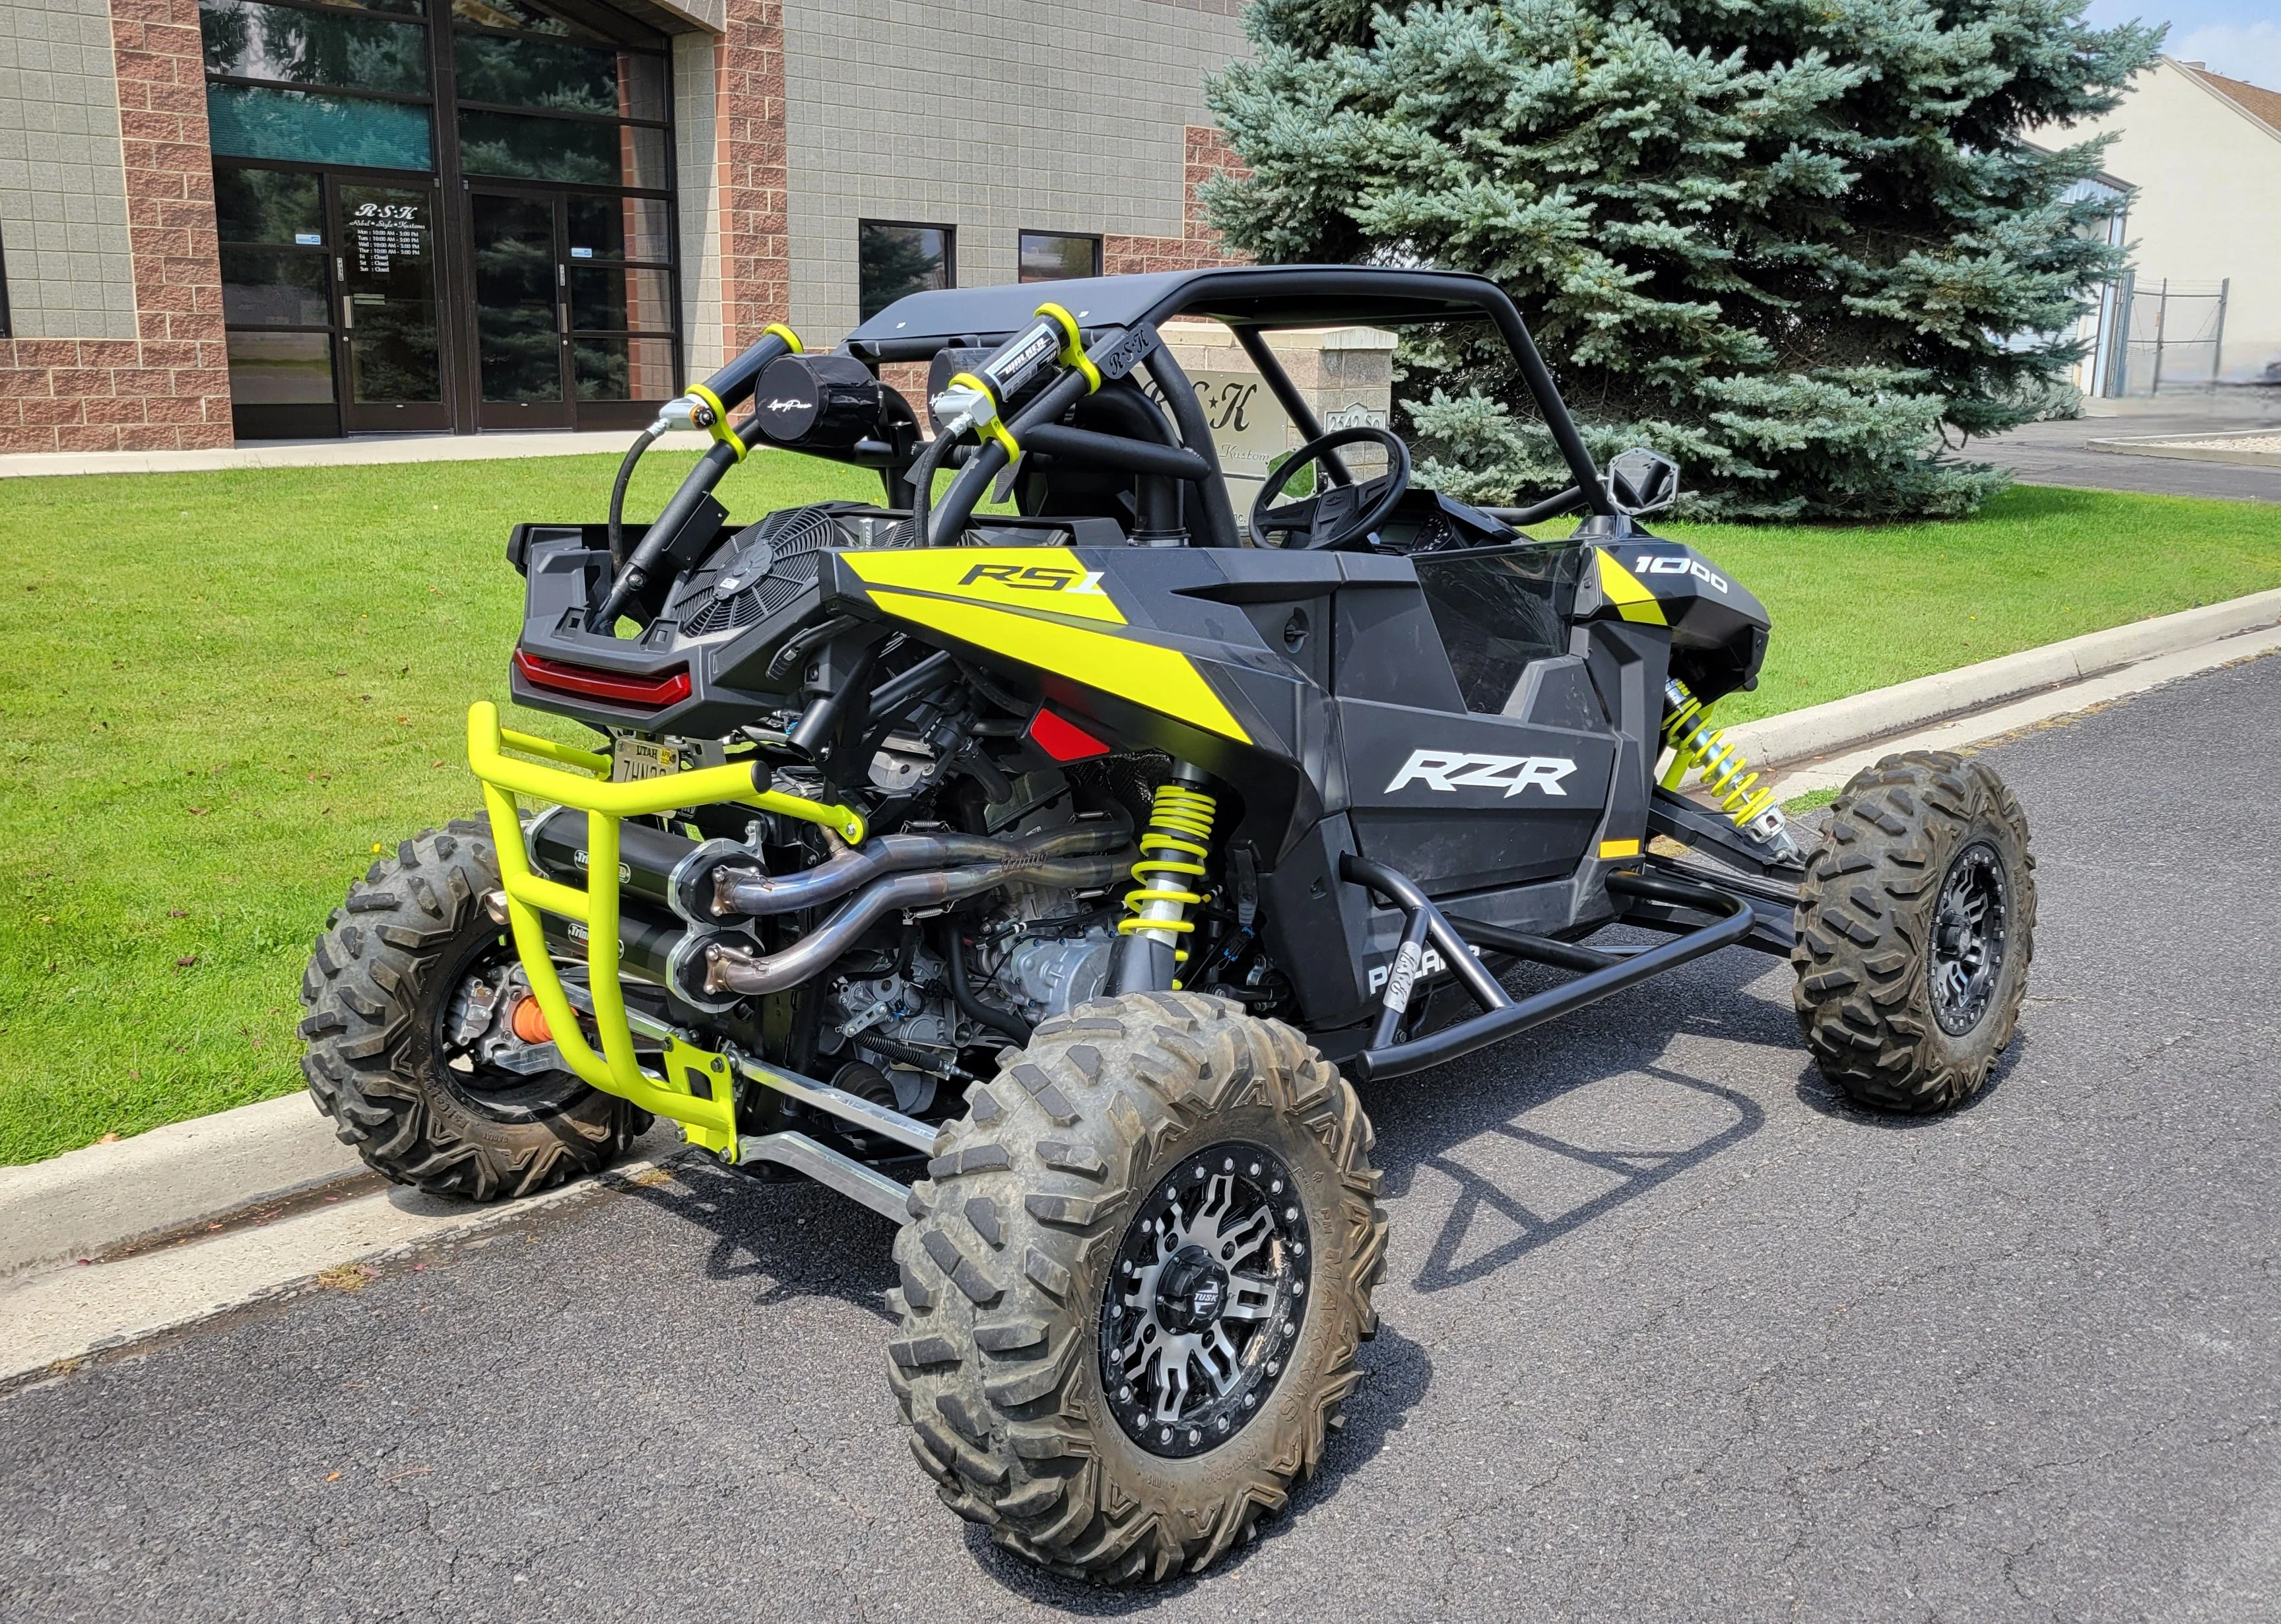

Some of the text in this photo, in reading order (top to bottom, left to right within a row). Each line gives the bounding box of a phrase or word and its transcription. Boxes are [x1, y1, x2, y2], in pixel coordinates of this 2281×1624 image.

[996, 337, 1051, 376] WALKER
[958, 564, 1107, 596] RS1
[1635, 556, 1728, 594] 1000
[636, 745, 657, 760] UTAH
[623, 760, 667, 783] 7HN
[1384, 750, 1578, 798] RZR
[1194, 1293, 1218, 1302] TUSK
